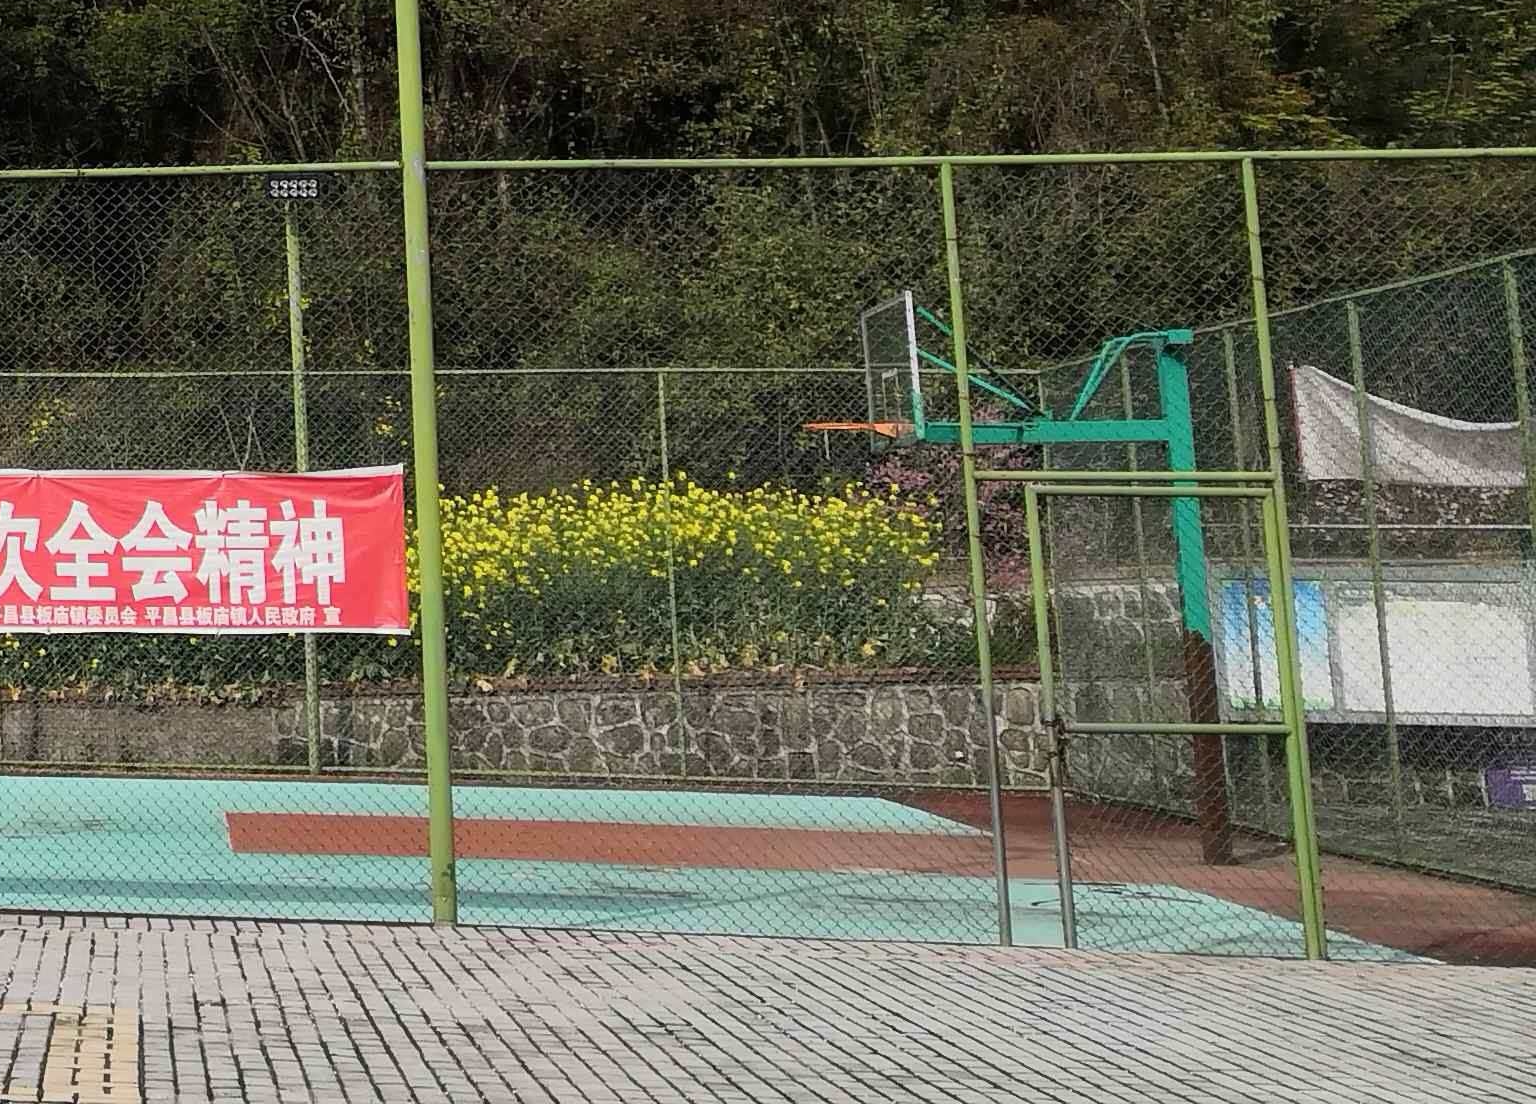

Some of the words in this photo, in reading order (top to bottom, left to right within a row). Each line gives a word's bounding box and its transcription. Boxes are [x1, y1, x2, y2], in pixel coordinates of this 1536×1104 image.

[145, 606, 316, 626] 平昌县板庙镇人民政府
[323, 606, 342, 625] 宣
